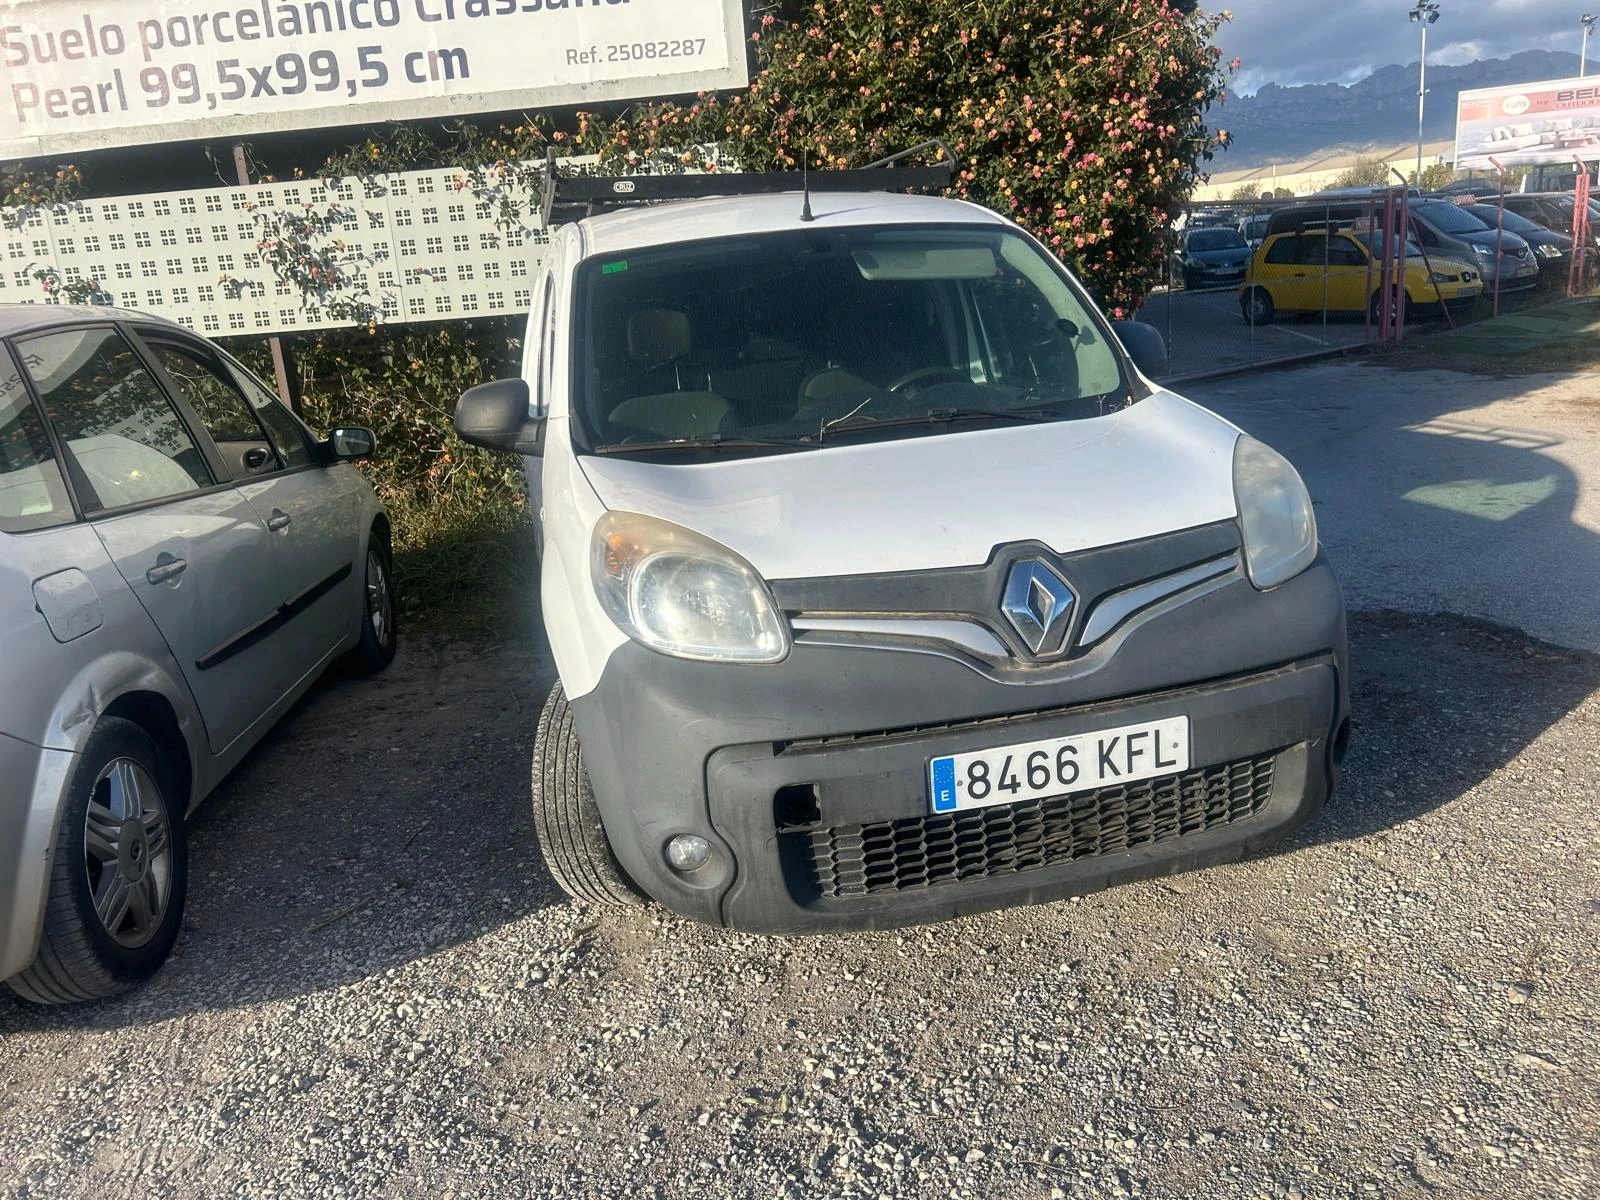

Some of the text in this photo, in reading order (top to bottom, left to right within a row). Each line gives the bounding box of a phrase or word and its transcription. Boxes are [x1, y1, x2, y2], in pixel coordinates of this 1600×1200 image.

[0, 14, 126, 67] Suelo
[565, 38, 706, 65] Ref. 25082287
[11, 45, 470, 122] Pearl 99,5x99,5 cm
[941, 729, 1177, 802] E 8466 KFL
